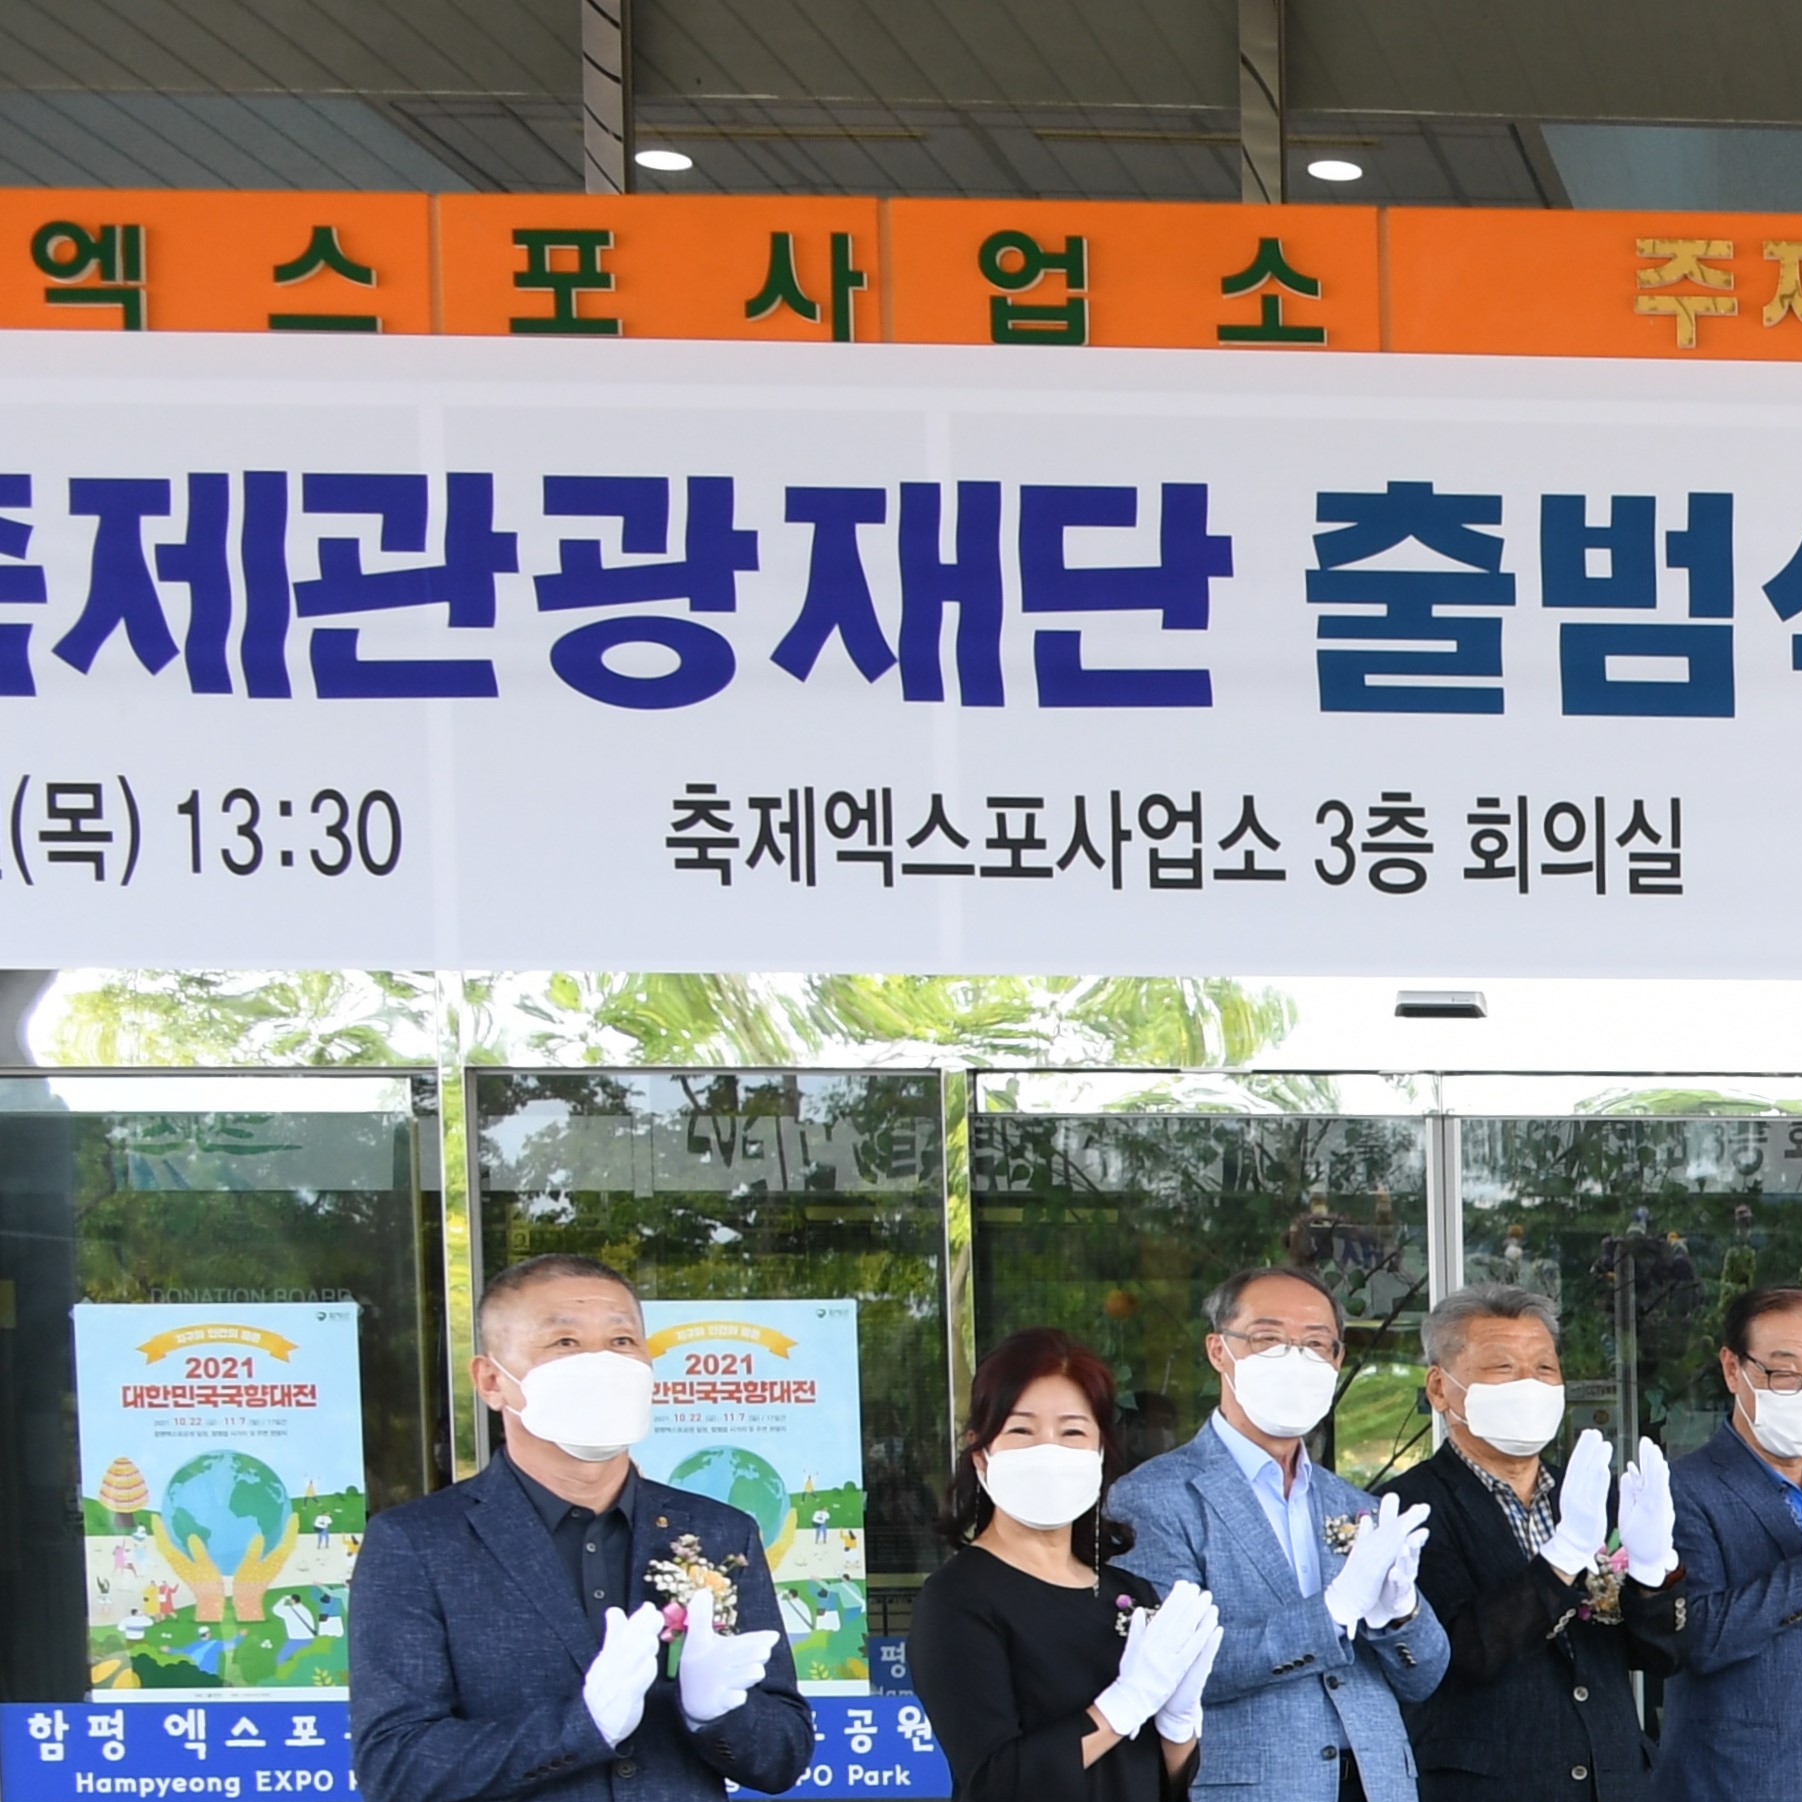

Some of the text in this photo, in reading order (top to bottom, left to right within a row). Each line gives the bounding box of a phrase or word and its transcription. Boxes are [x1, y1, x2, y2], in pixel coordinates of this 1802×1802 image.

[0, 470, 1234, 709] 제관광재단
[0, 775, 402, 886] (목) 13:30
[666, 783, 1684, 896] 축제엑스포사업소 3층 회의실
[185, 1357, 254, 1379] 2021
[685, 1353, 754, 1376] 2021
[121, 1383, 317, 1409] 대한민국국향대전
[880, 1641, 906, 1679] 평
[28, 1708, 352, 1761] 함평 엑스포
[811, 1705, 935, 1754] 공원
[76, 1772, 241, 1798] Hampyeong
[256, 1770, 333, 1792] EXPO
[848, 1764, 911, 1786] Park
